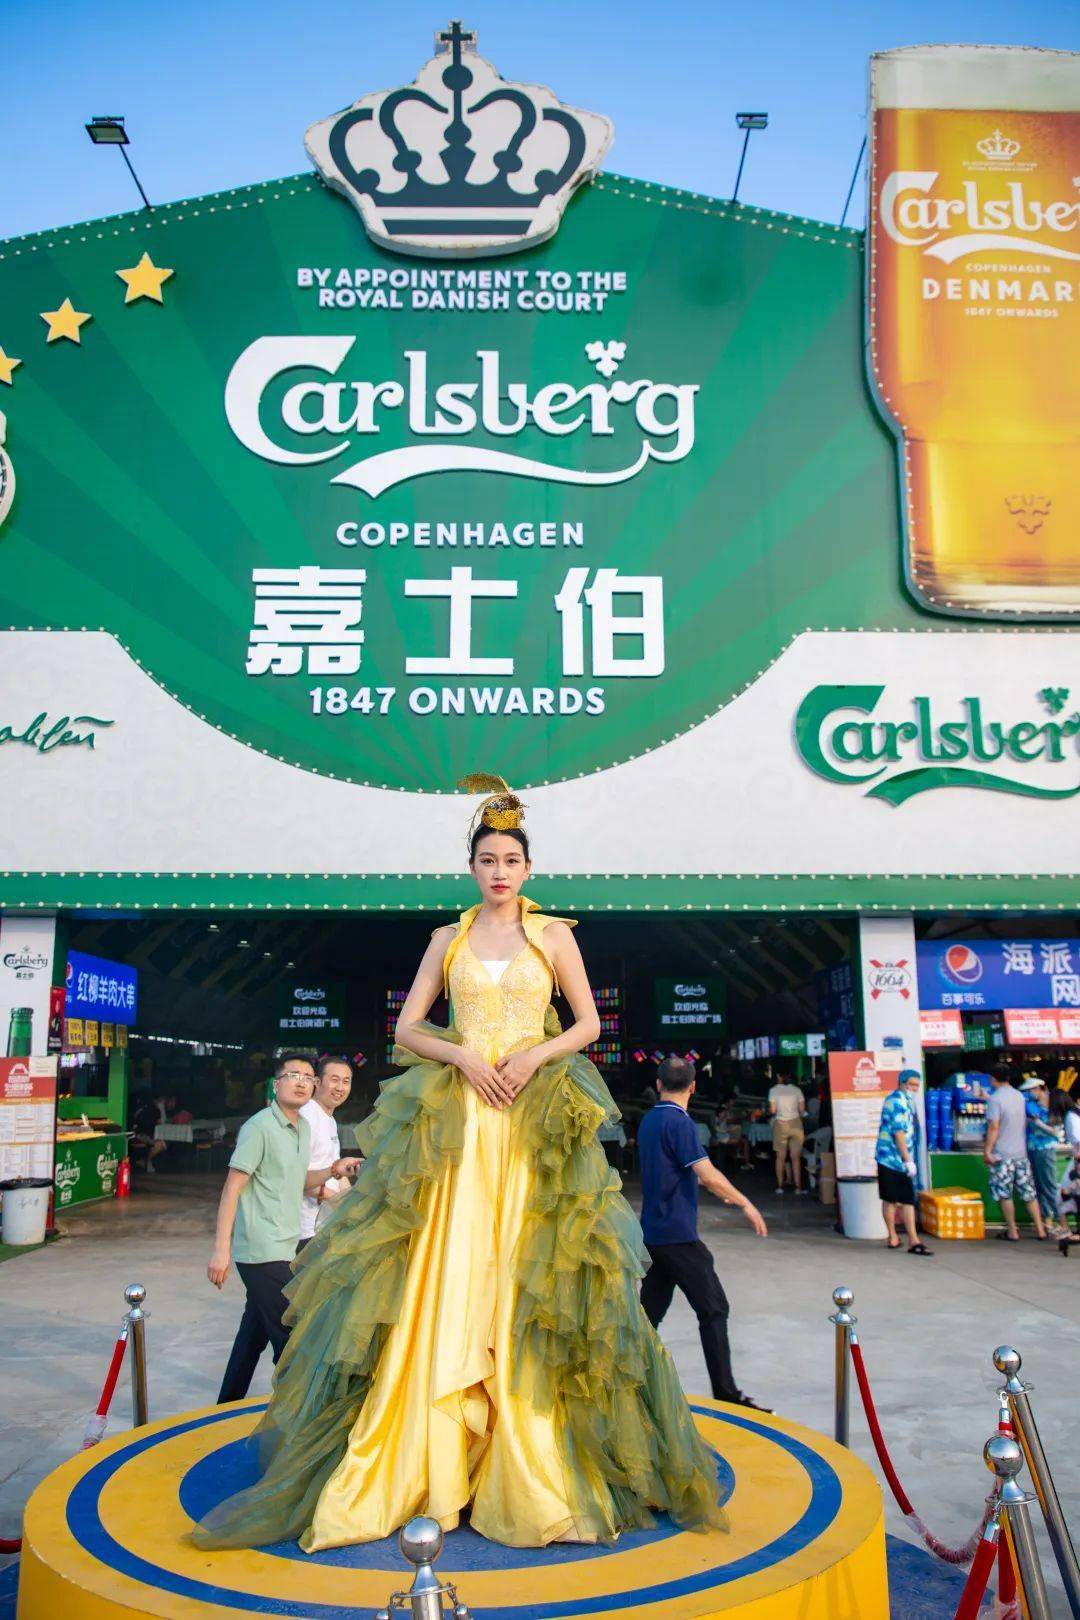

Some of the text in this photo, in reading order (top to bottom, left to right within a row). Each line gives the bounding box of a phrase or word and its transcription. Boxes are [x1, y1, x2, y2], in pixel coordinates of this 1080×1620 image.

[880, 171, 1080, 264] Carlsbe
[297, 268, 627, 292] BY APPOINTMENT TO THE
[966, 264, 1051, 274] COPENHAGEN
[319, 289, 608, 312] ROYAL DANISH COURT
[922, 278, 1080, 302] DENMAR
[996, 308, 1058, 318] ONWARDS
[224, 335, 700, 498] Carlsberg
[336, 522, 584, 547] COPENHAGEN
[246, 566, 665, 678] 嘉士伯
[310, 687, 605, 716] 1847 ONWARDS
[795, 684, 1080, 808] Carlsber
[1002, 943, 1080, 974] 海派
